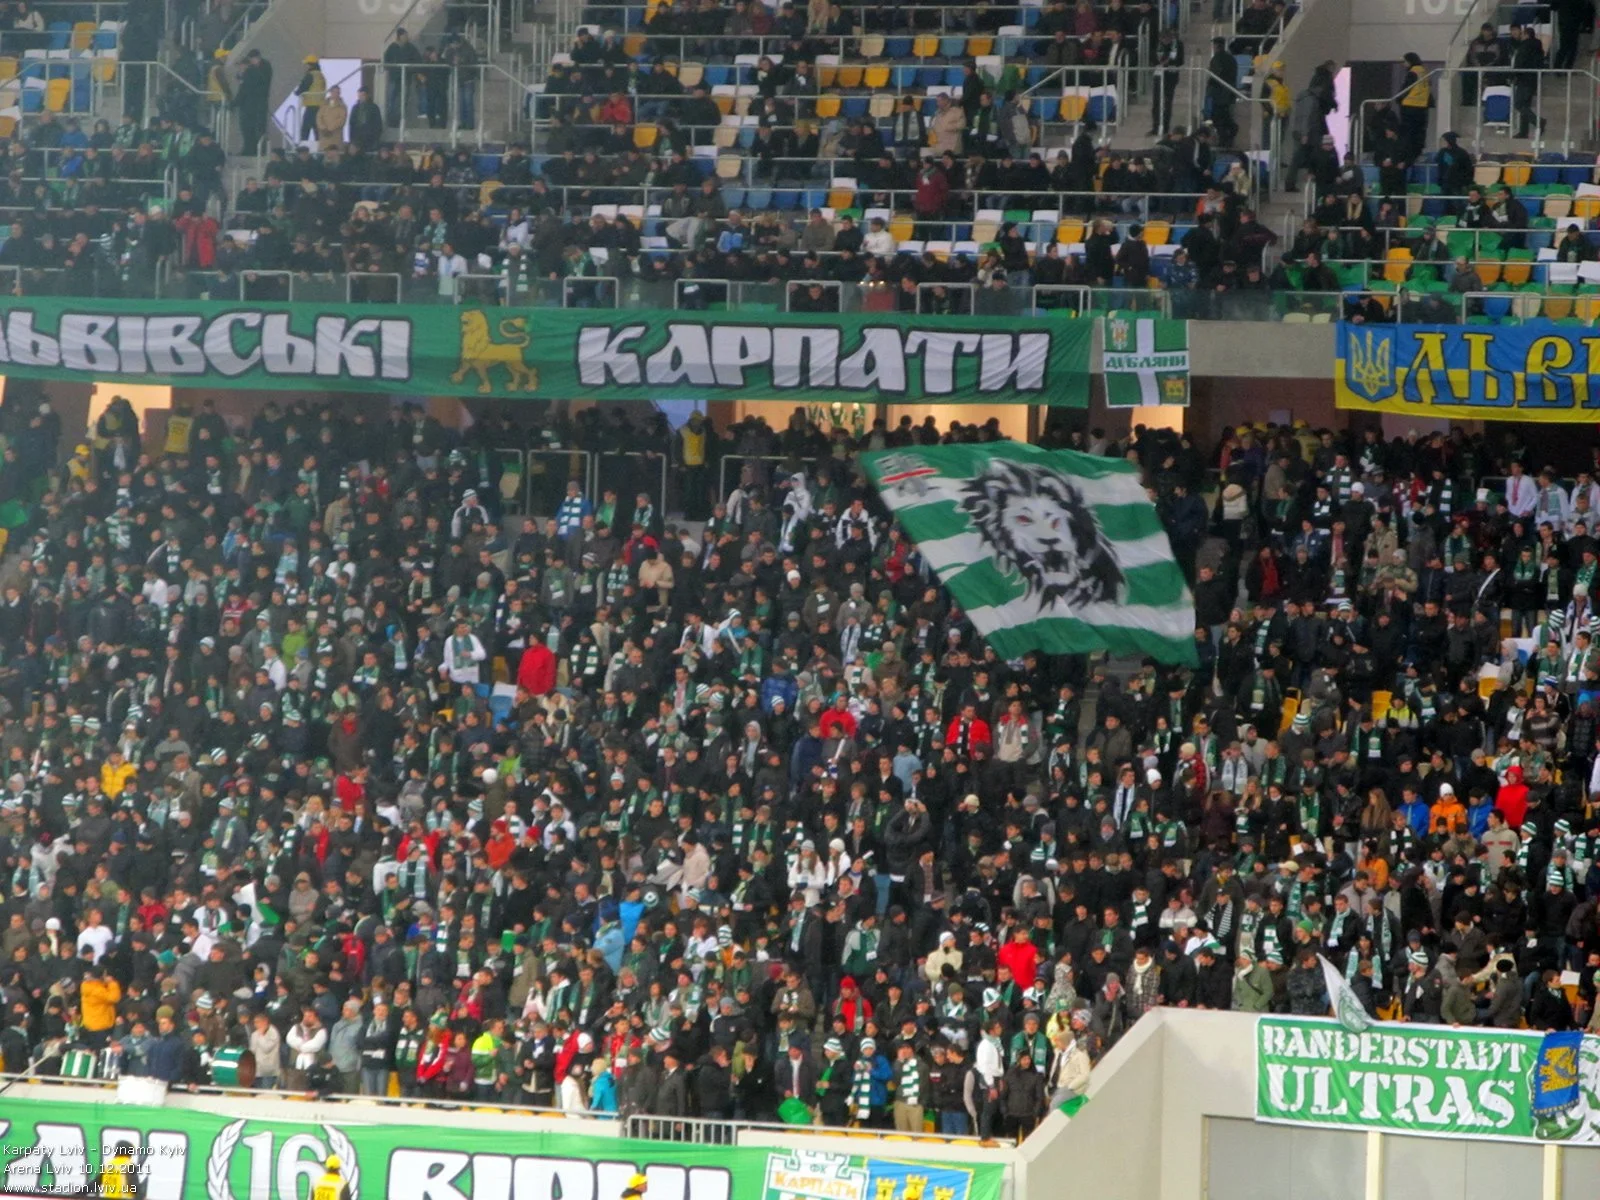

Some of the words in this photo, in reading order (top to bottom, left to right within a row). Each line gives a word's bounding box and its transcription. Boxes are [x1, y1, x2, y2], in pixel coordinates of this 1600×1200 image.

[0, 310, 411, 379] ЬВІВСЬКІ
[578, 325, 1050, 393] КАРПАТИ
[1263, 1025, 1527, 1072] BANDERSTADT
[1266, 1063, 1516, 1128] ULTRAS
[243, 1131, 329, 1200] 16
[775, 1171, 858, 1199] КАРПАТИ
